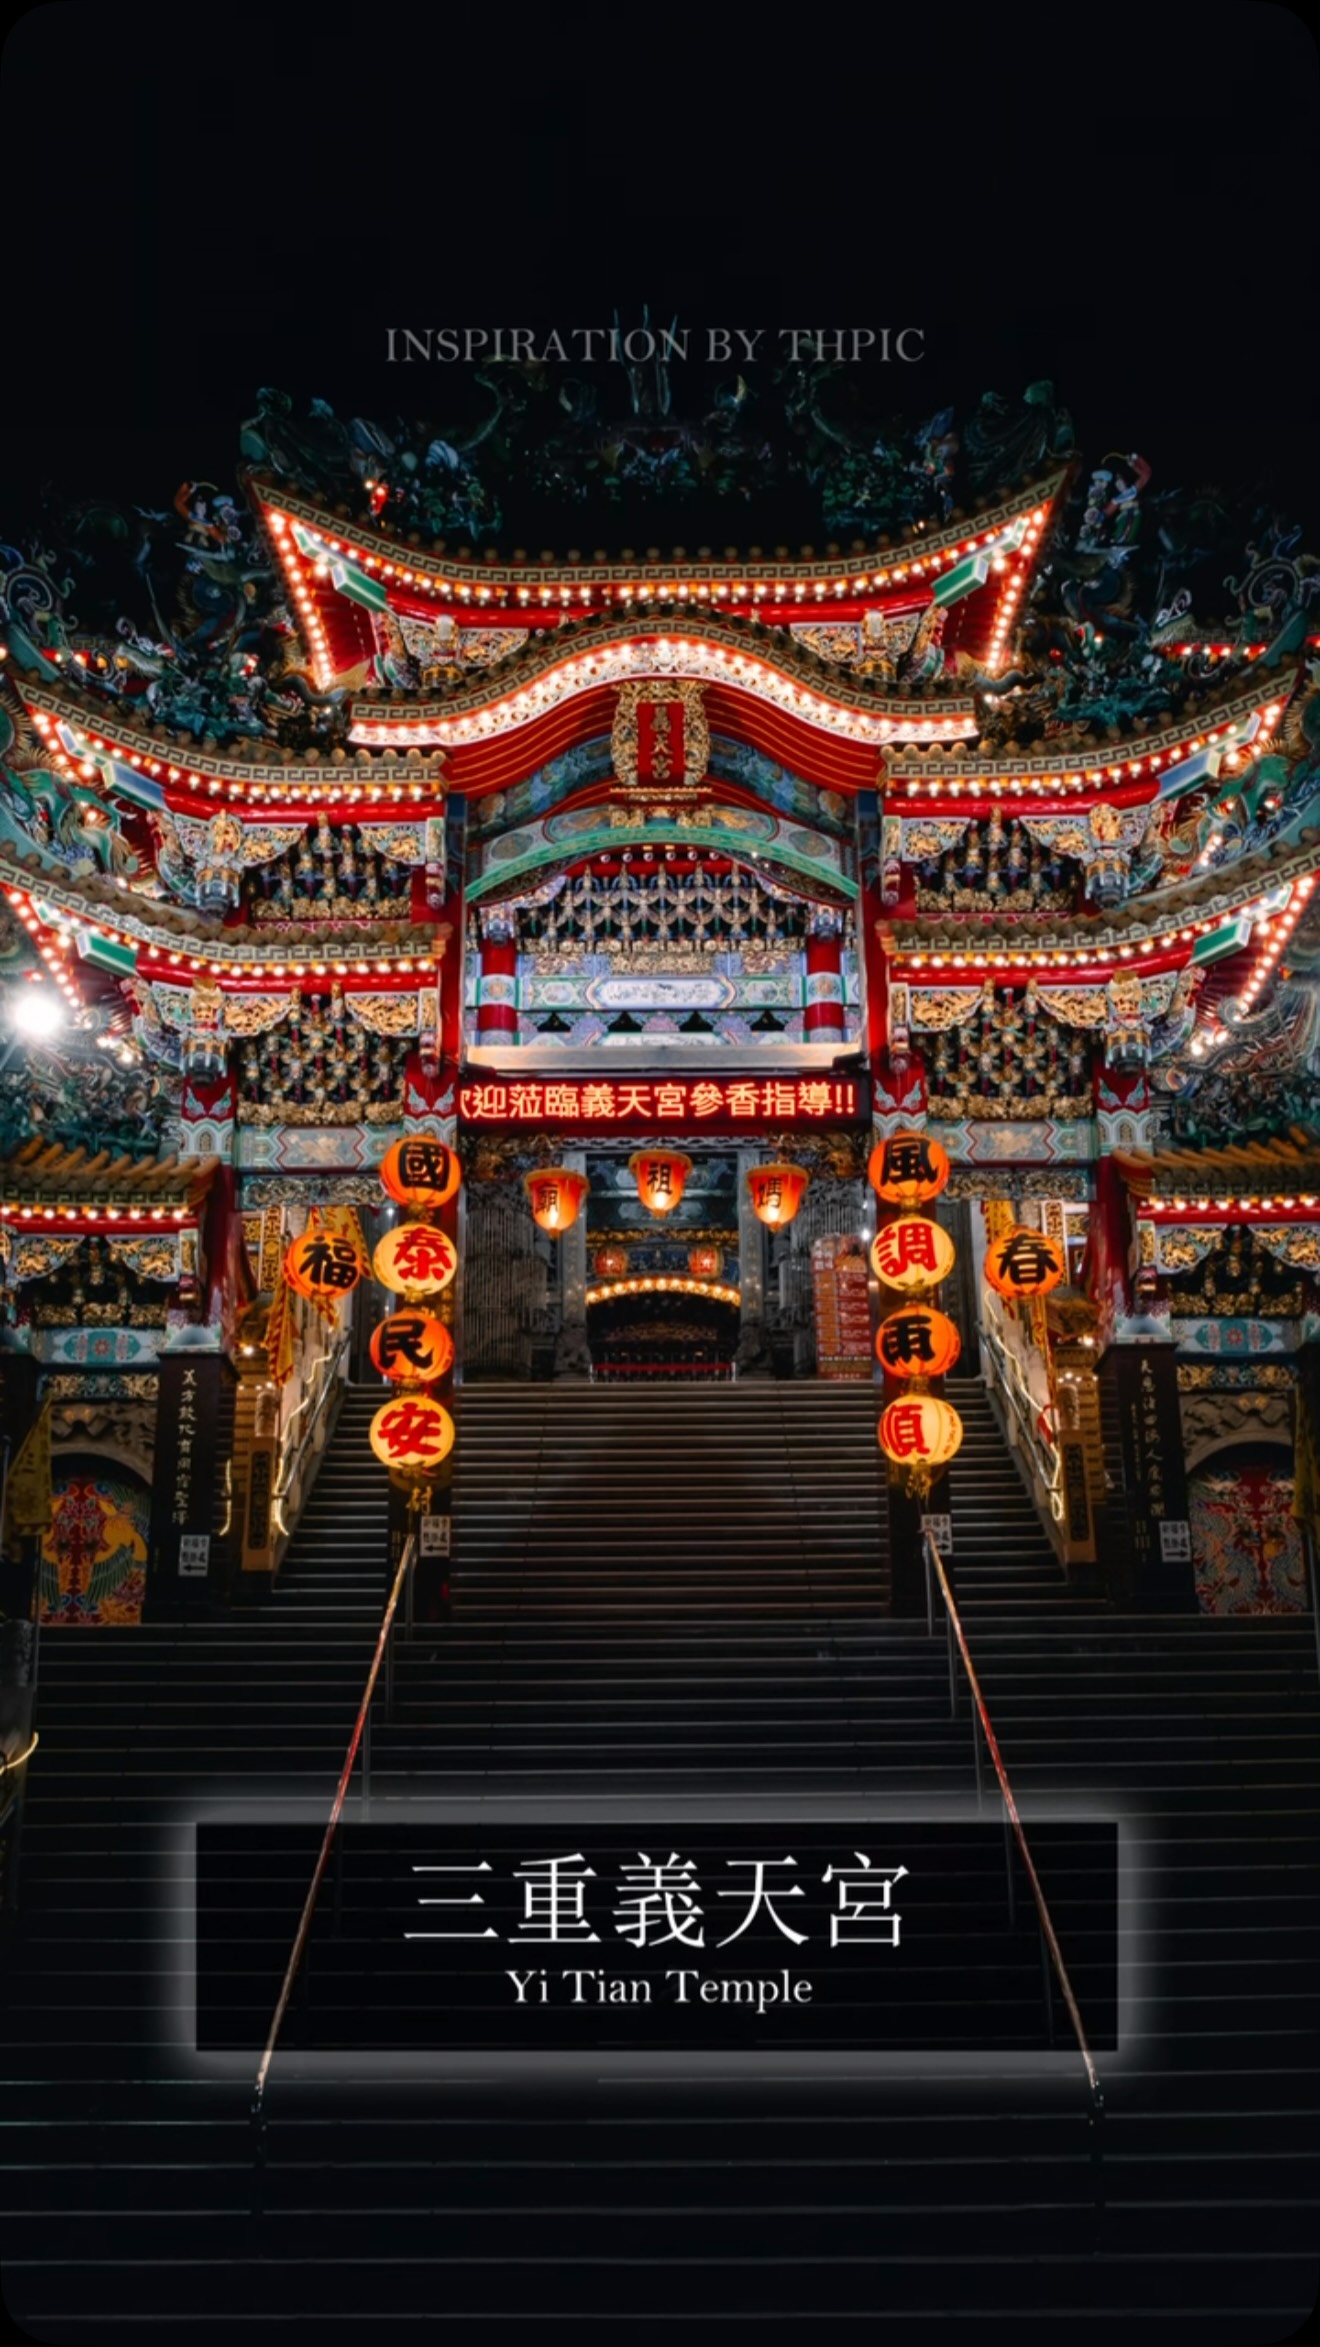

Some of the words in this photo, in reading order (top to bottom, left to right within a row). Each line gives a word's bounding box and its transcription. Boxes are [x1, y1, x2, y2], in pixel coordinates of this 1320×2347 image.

[646, 1161, 673, 1196] 祖
[299, 1234, 360, 1290] 福
[996, 1232, 1060, 1287] 春
